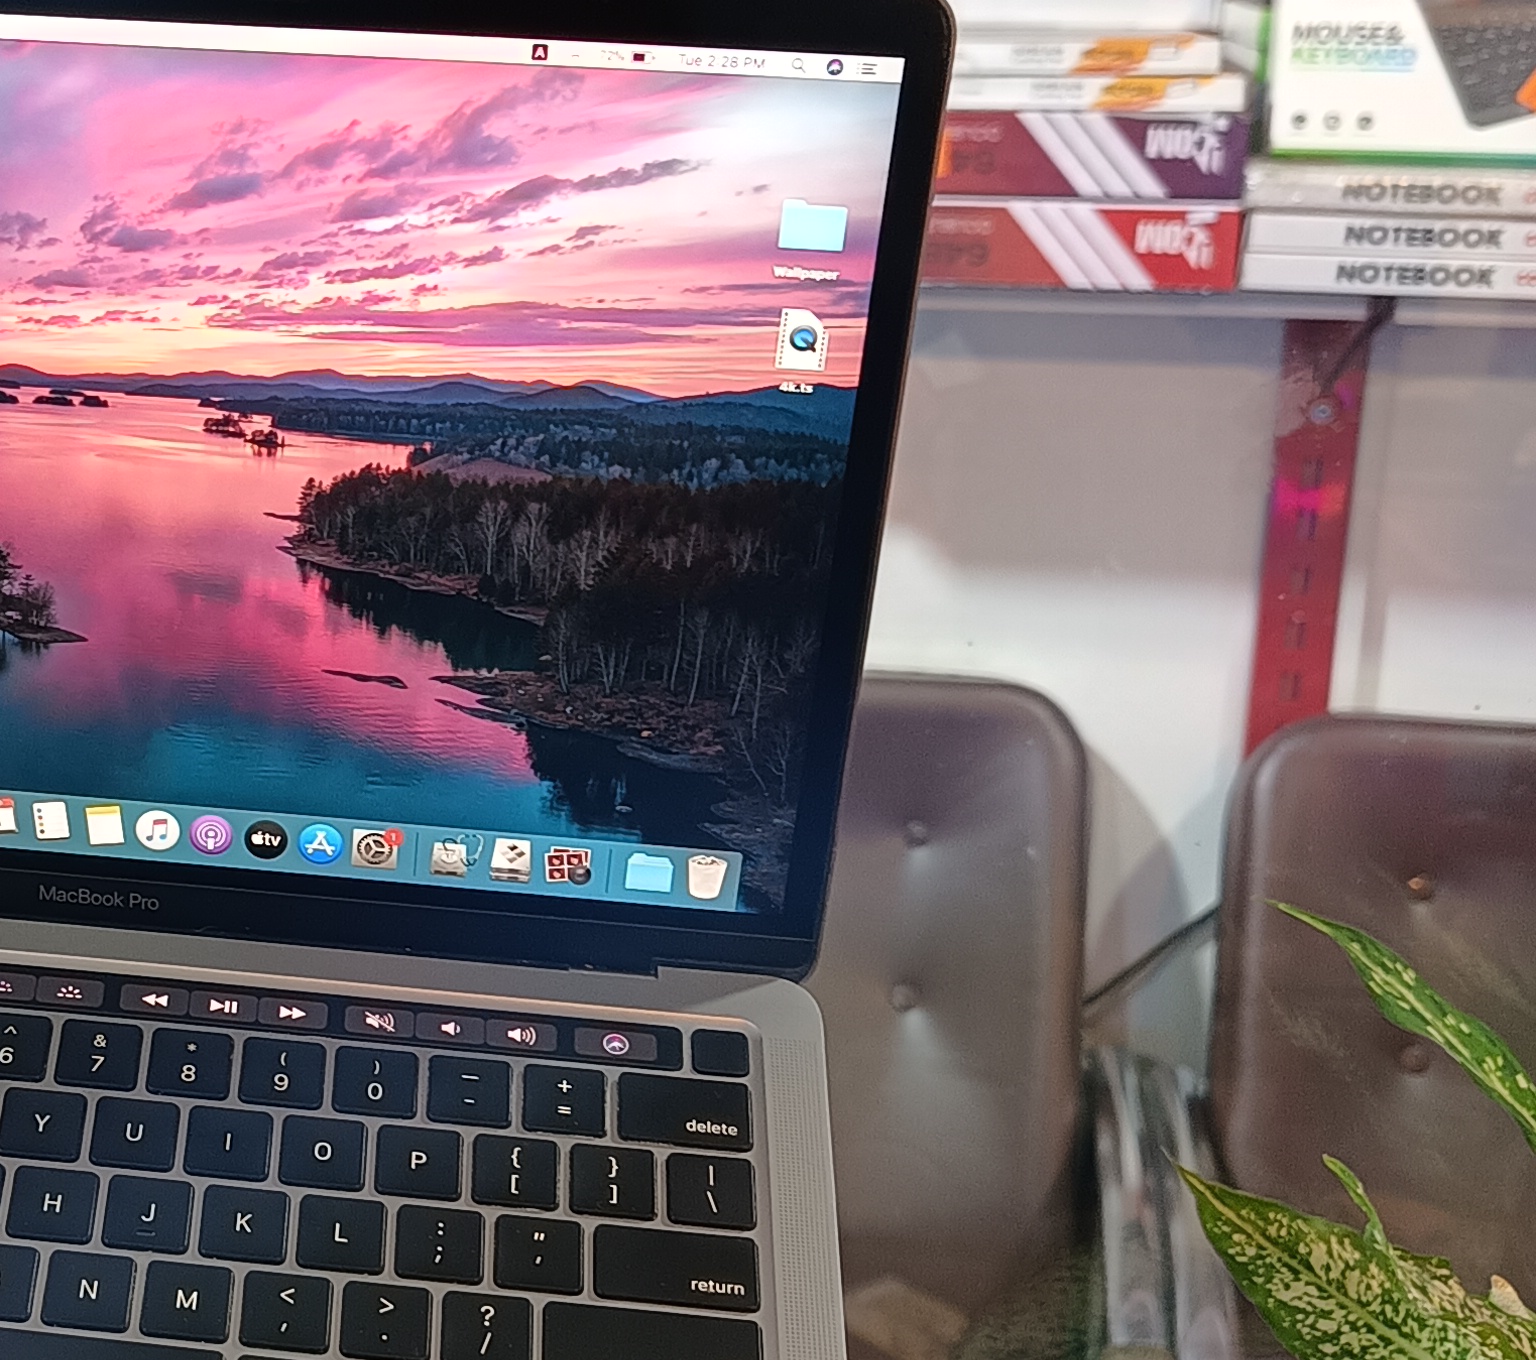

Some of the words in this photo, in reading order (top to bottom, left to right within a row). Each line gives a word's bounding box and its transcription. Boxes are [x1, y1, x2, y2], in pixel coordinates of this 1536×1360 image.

[678, 53, 702, 68] Tue
[746, 56, 766, 70] PM
[1341, 183, 1503, 206] NOTEBOOK
[1344, 225, 1505, 249] NOTEBOOK
[772, 264, 841, 282] Wallpaper
[1336, 263, 1498, 289] NOTEBOOK
[779, 380, 814, 395] 4k.ts
[38, 884, 125, 908] MacBook
[128, 891, 160, 911] Pro
[91, 1055, 105, 1072] 7
[180, 1064, 196, 1082] 8
[273, 1073, 289, 1091] 9
[367, 1082, 383, 1100] 0
[34, 1113, 51, 1132] Y
[125, 1122, 144, 1142] U
[685, 1119, 738, 1136] delete
[225, 1132, 232, 1151] I
[314, 1142, 332, 1161] O
[411, 1151, 427, 1170] P
[43, 1193, 62, 1213] H
[140, 1203, 156, 1222] J
[235, 1212, 253, 1233] K
[334, 1222, 348, 1243] L
[79, 1279, 99, 1300] N
[691, 1279, 745, 1296] return
[175, 1289, 198, 1311] M
